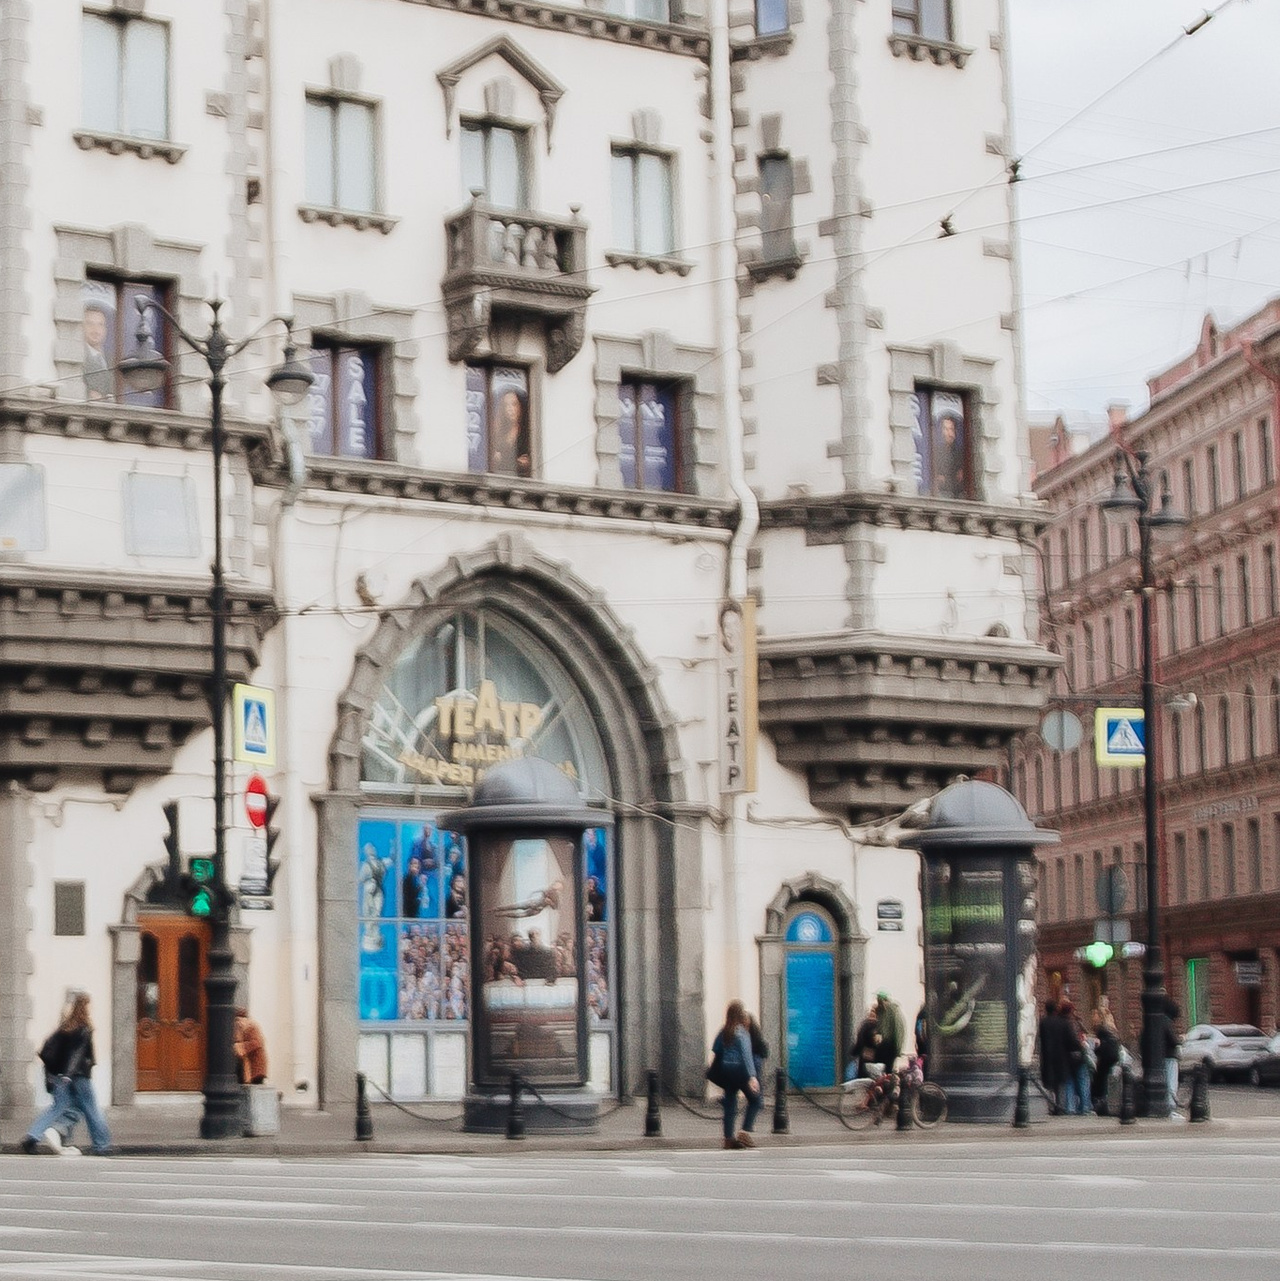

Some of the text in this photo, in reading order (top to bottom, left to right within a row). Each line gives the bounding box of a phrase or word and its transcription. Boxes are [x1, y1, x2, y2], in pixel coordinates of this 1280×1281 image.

[348, 356, 367, 451] SALE
[435, 679, 543, 741] ТЕАТР
[726, 667, 741, 786] ТЕАТР
